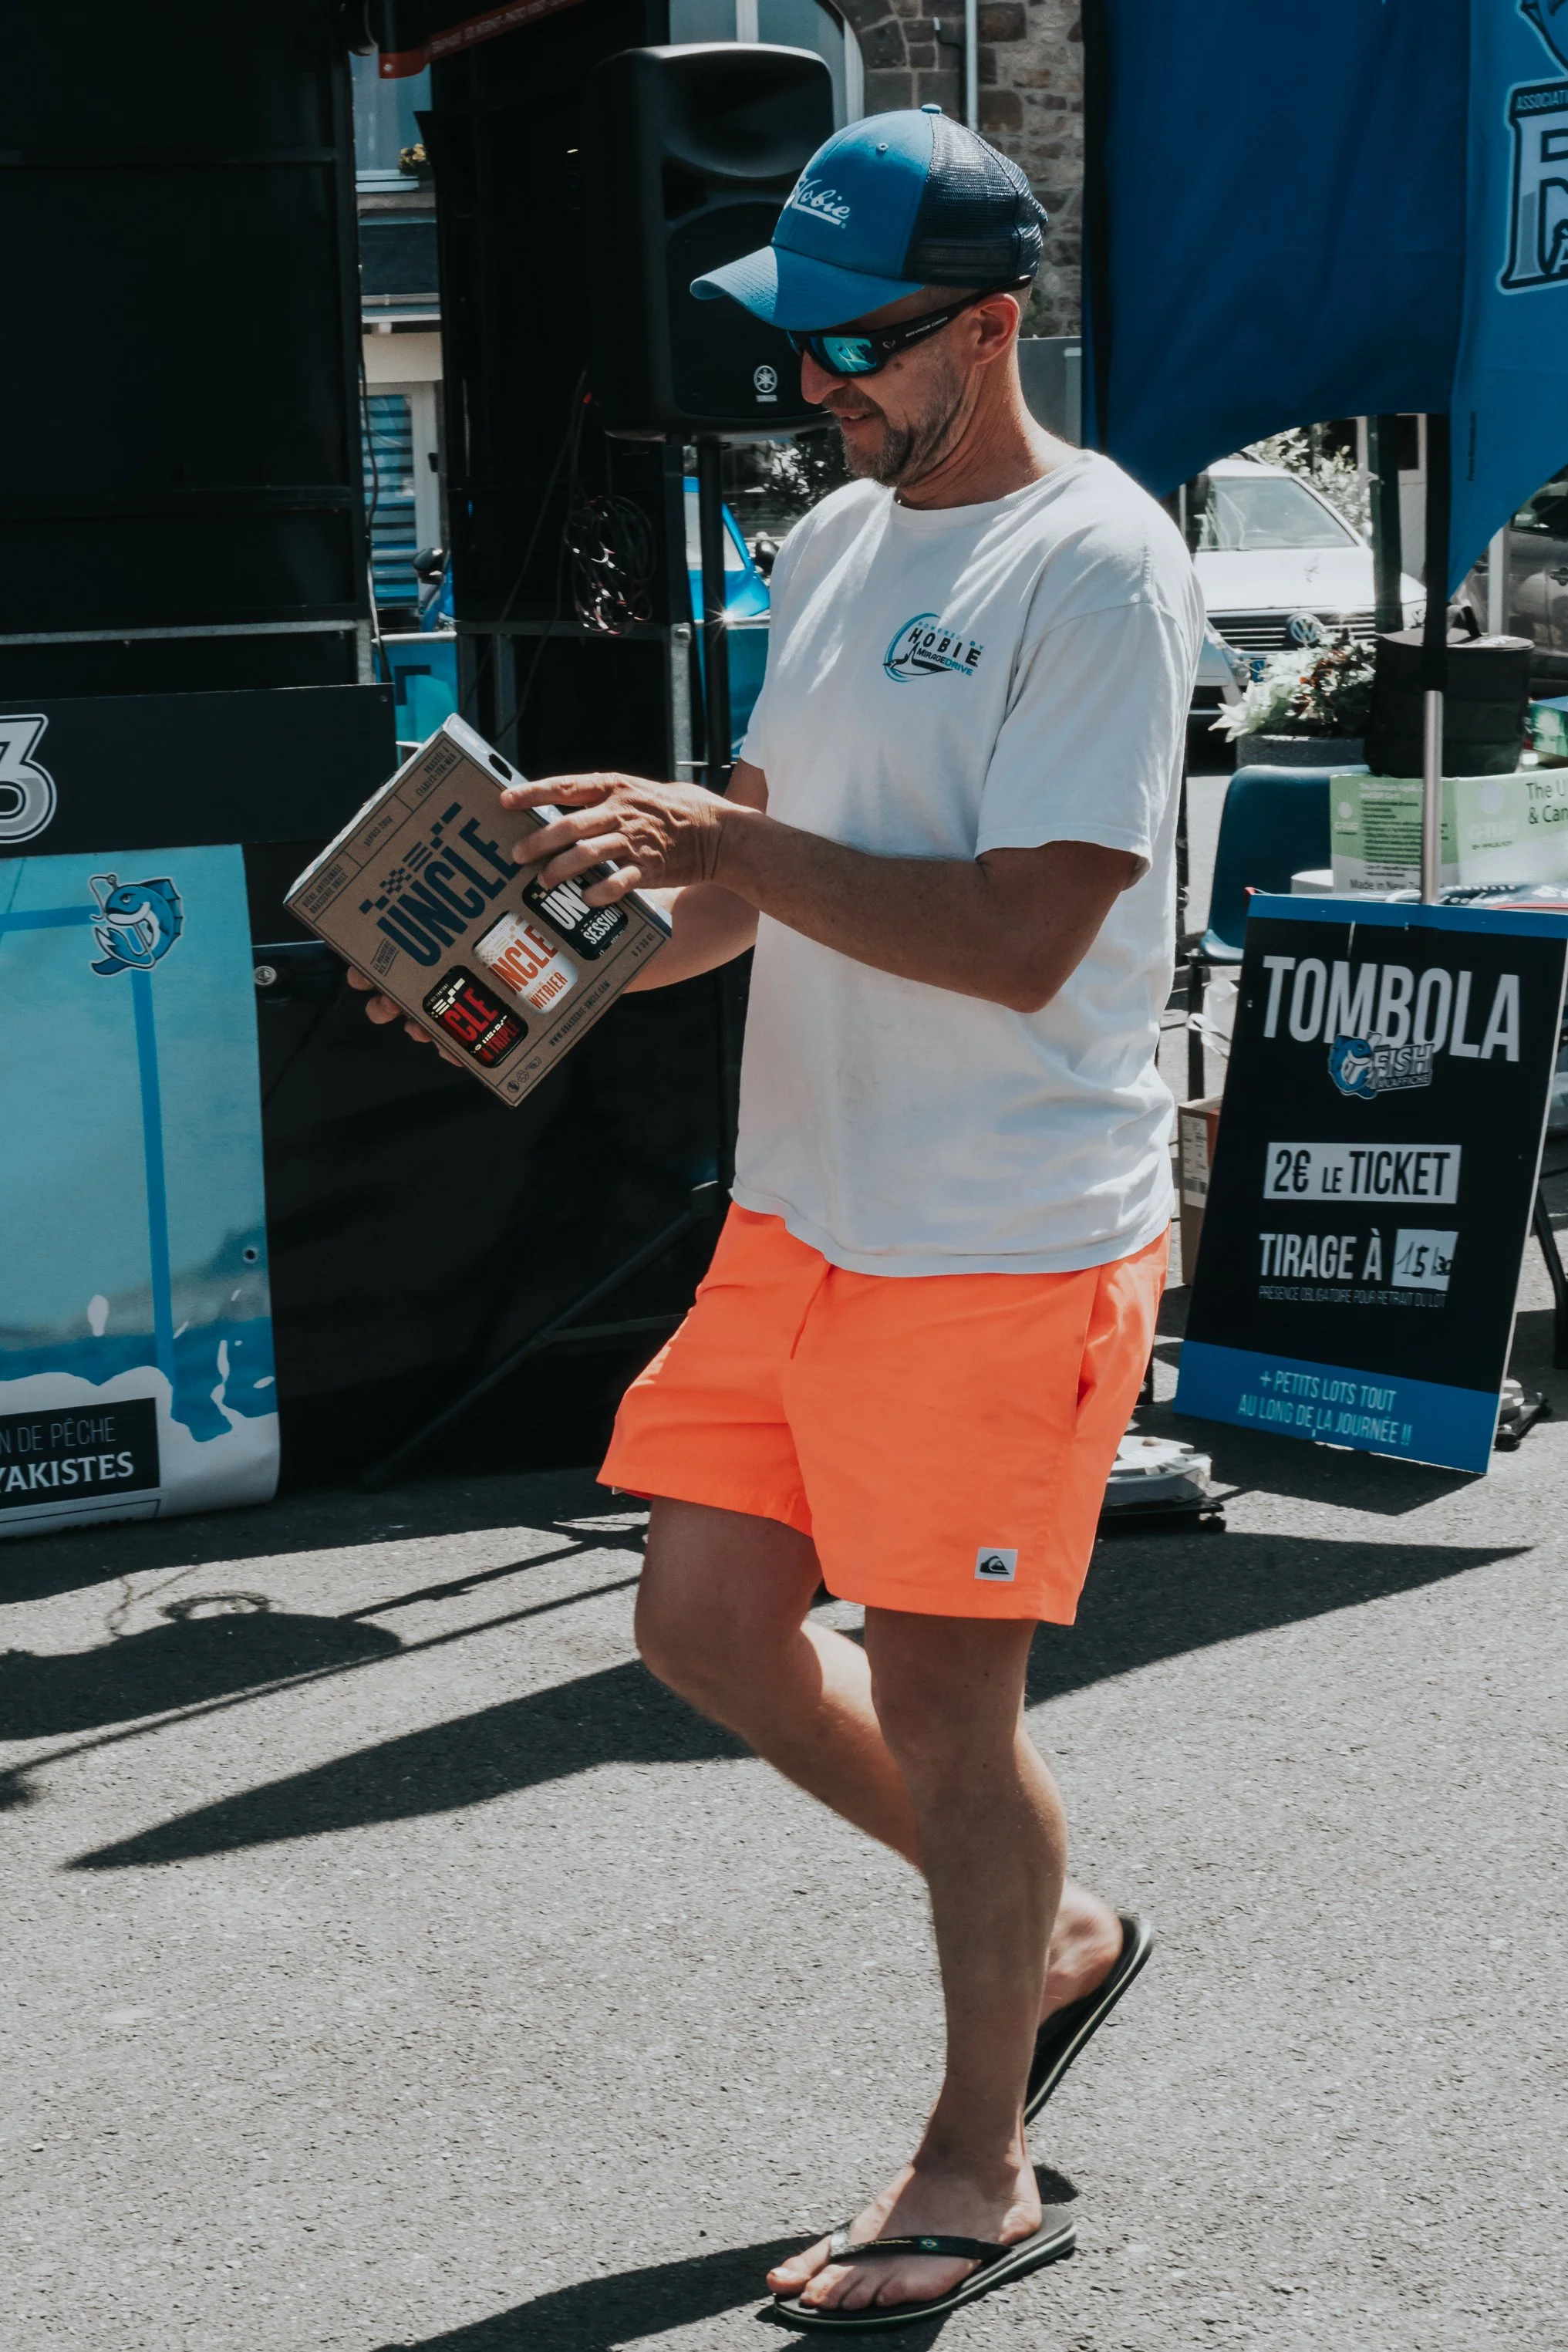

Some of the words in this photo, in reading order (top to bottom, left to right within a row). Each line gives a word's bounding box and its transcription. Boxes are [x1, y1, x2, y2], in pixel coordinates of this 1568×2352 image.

[908, 627, 982, 667] HOBIE
[1526, 781, 1553, 801] The
[1529, 807, 1539, 825] &
[376, 818, 523, 967] UNCLE
[528, 972, 568, 1010] WITBIER
[1263, 955, 1519, 1062] TOMBOLA
[1273, 1149, 1311, 1193] 2€
[1322, 1166, 1343, 1193] LE
[1350, 1150, 1451, 1196] TICKET
[1259, 1233, 1357, 1280] TIRAGE
[1361, 1227, 1383, 1281] À
[1274, 1370, 1320, 1399] PETITS
[1322, 1378, 1357, 1405] LOTS
[1360, 1385, 1397, 1412] TOUT
[17, 1425, 44, 1453] DE
[50, 1416, 117, 1449] PÊCHE
[1237, 1393, 1258, 1417] AU
[1258, 1397, 1294, 1423] LONG
[1295, 1404, 1314, 1428] DE
[1316, 1408, 1333, 1432] LA
[1335, 1411, 1400, 1443] JOURNÉE
